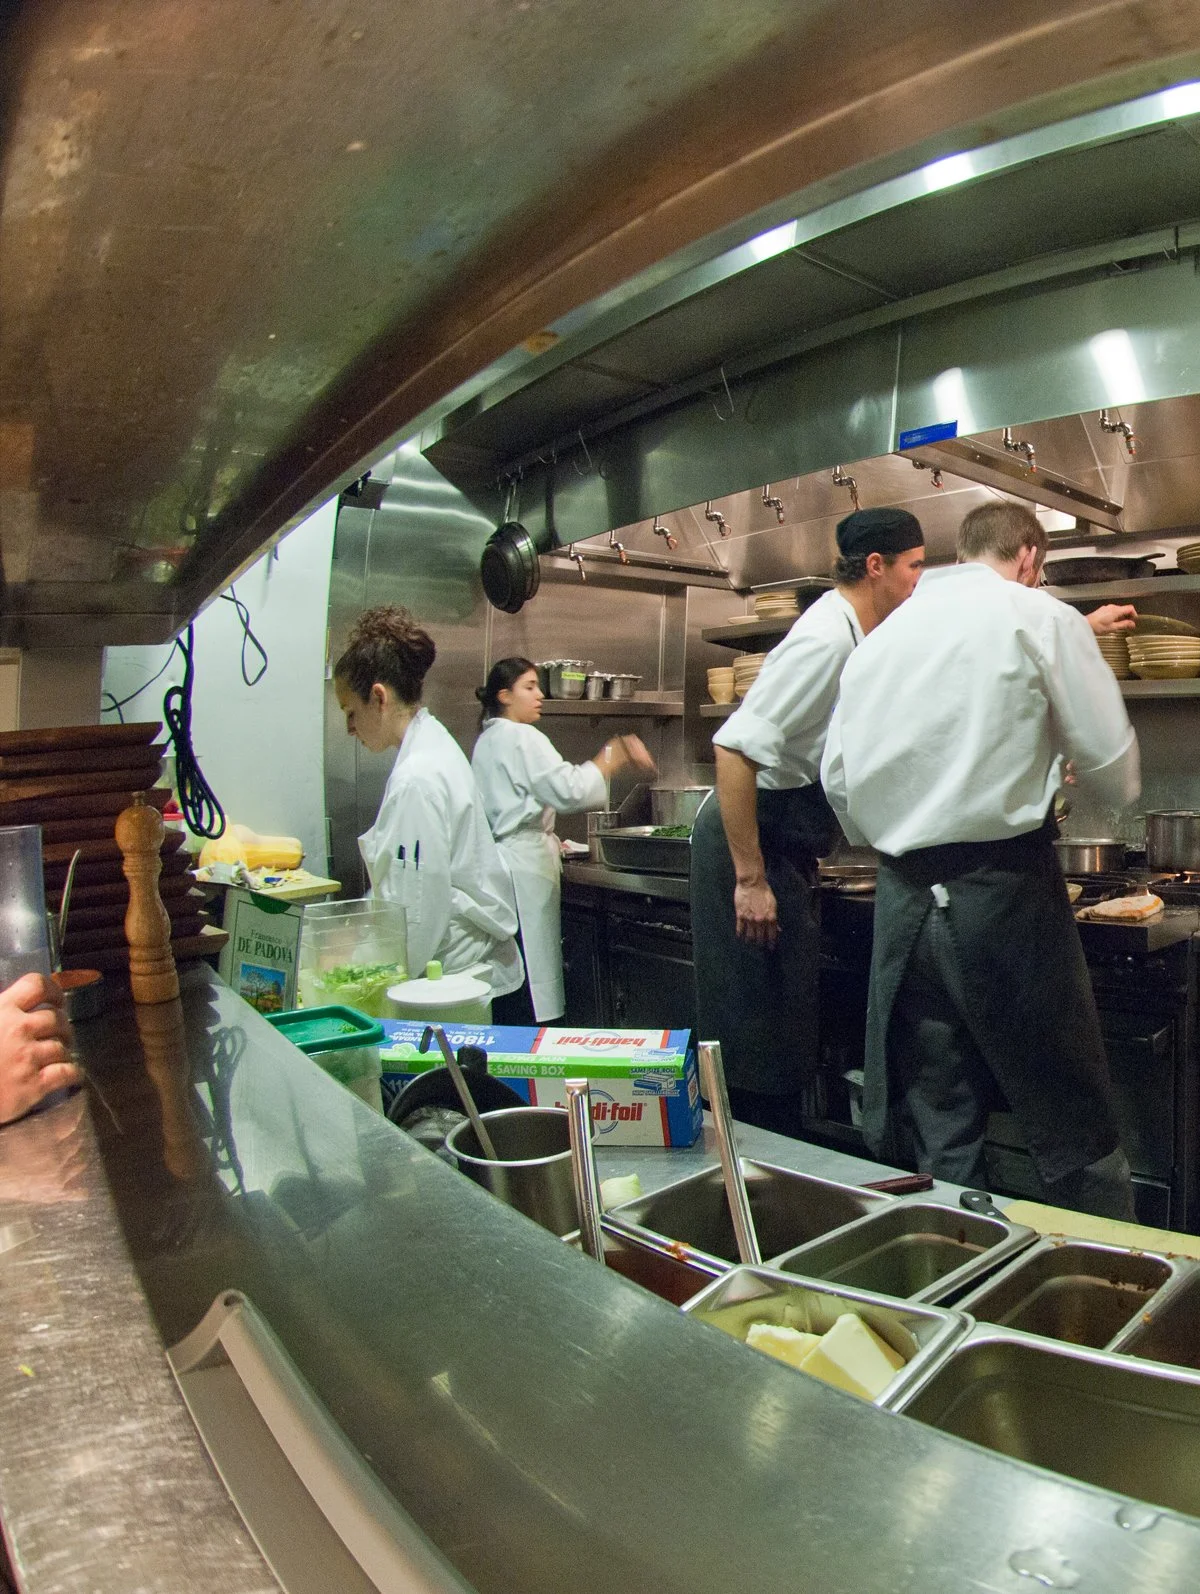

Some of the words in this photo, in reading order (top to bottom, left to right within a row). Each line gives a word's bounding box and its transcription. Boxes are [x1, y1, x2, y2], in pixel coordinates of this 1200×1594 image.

[238, 936, 252, 955] DE
[254, 940, 293, 963] PADOVA
[556, 1034, 646, 1048] handi-foil
[541, 1065, 566, 1077] BOX
